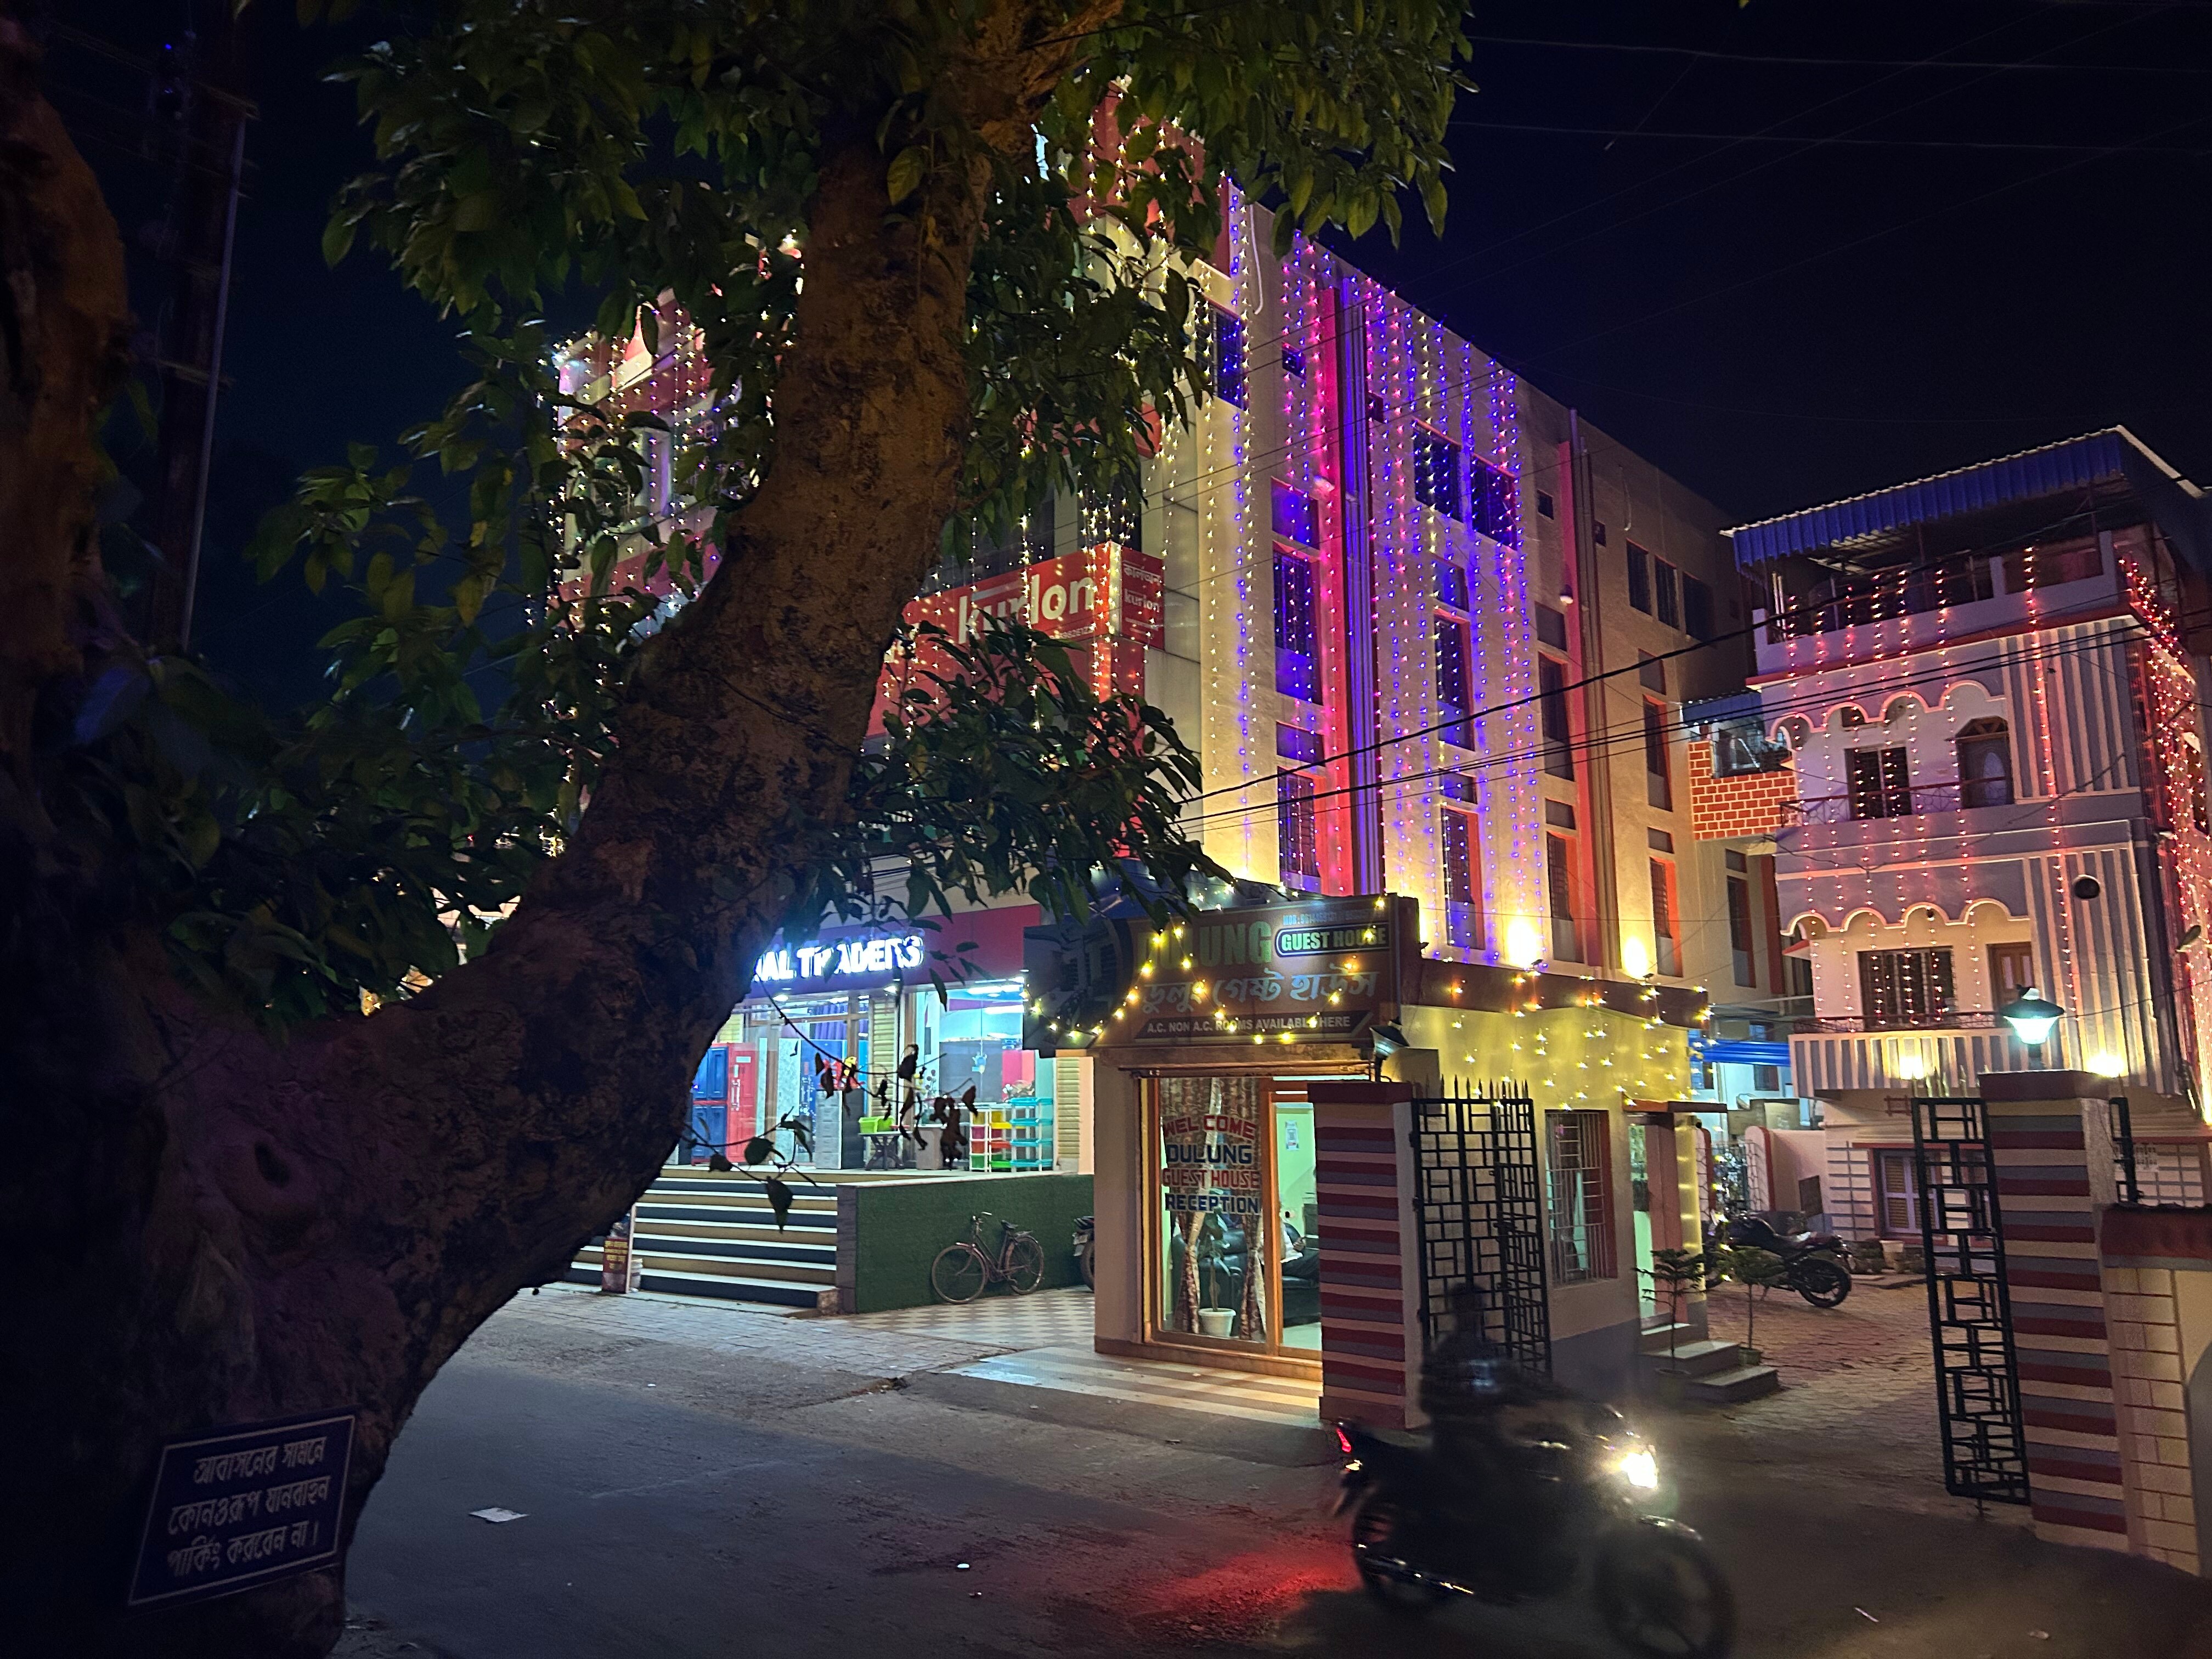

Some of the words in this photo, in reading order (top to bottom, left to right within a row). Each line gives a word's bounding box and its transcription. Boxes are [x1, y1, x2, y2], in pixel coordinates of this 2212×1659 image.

[958, 574, 1095, 644] kurlon
[1124, 588, 1160, 613] kurlon
[1281, 932, 1330, 951] GUEST
[1333, 927, 1386, 947] HOUSE
[1147, 1022, 1166, 1032] A.C.
[1169, 1021, 1189, 1032] NON
[1193, 1020, 1214, 1031] A.C.
[1319, 1016, 1351, 1028] HERE
[1166, 1144, 1252, 1164] DULUNG
[1163, 1168, 1207, 1187] GUEST
[1211, 1169, 1261, 1188] HOUSE
[1165, 1194, 1259, 1214] RECEPTION
[194, 1446, 279, 1484] আবাসনের
[282, 1436, 328, 1468] সামনে
[265, 1475, 332, 1513] যানবাহন
[227, 1526, 287, 1565] করবেন
